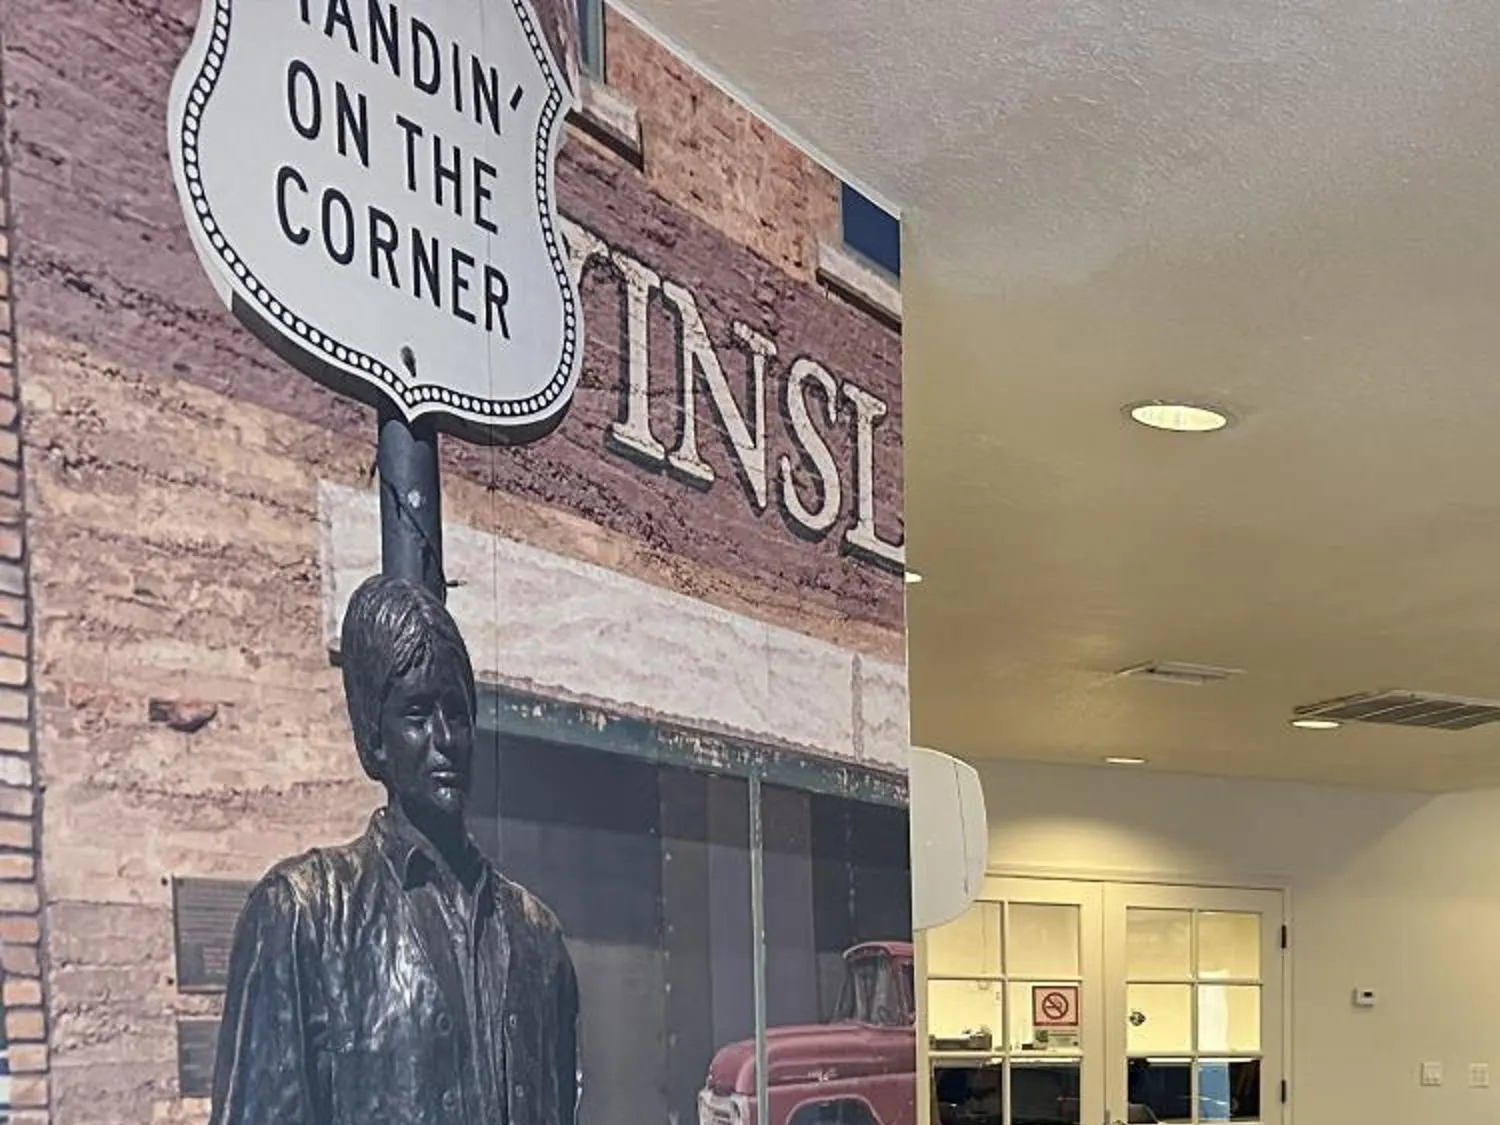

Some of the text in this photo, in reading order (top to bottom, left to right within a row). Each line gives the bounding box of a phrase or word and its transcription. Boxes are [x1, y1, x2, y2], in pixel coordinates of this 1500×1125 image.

[287, 59, 499, 236] ON THE
[276, 165, 511, 341] CORNER
